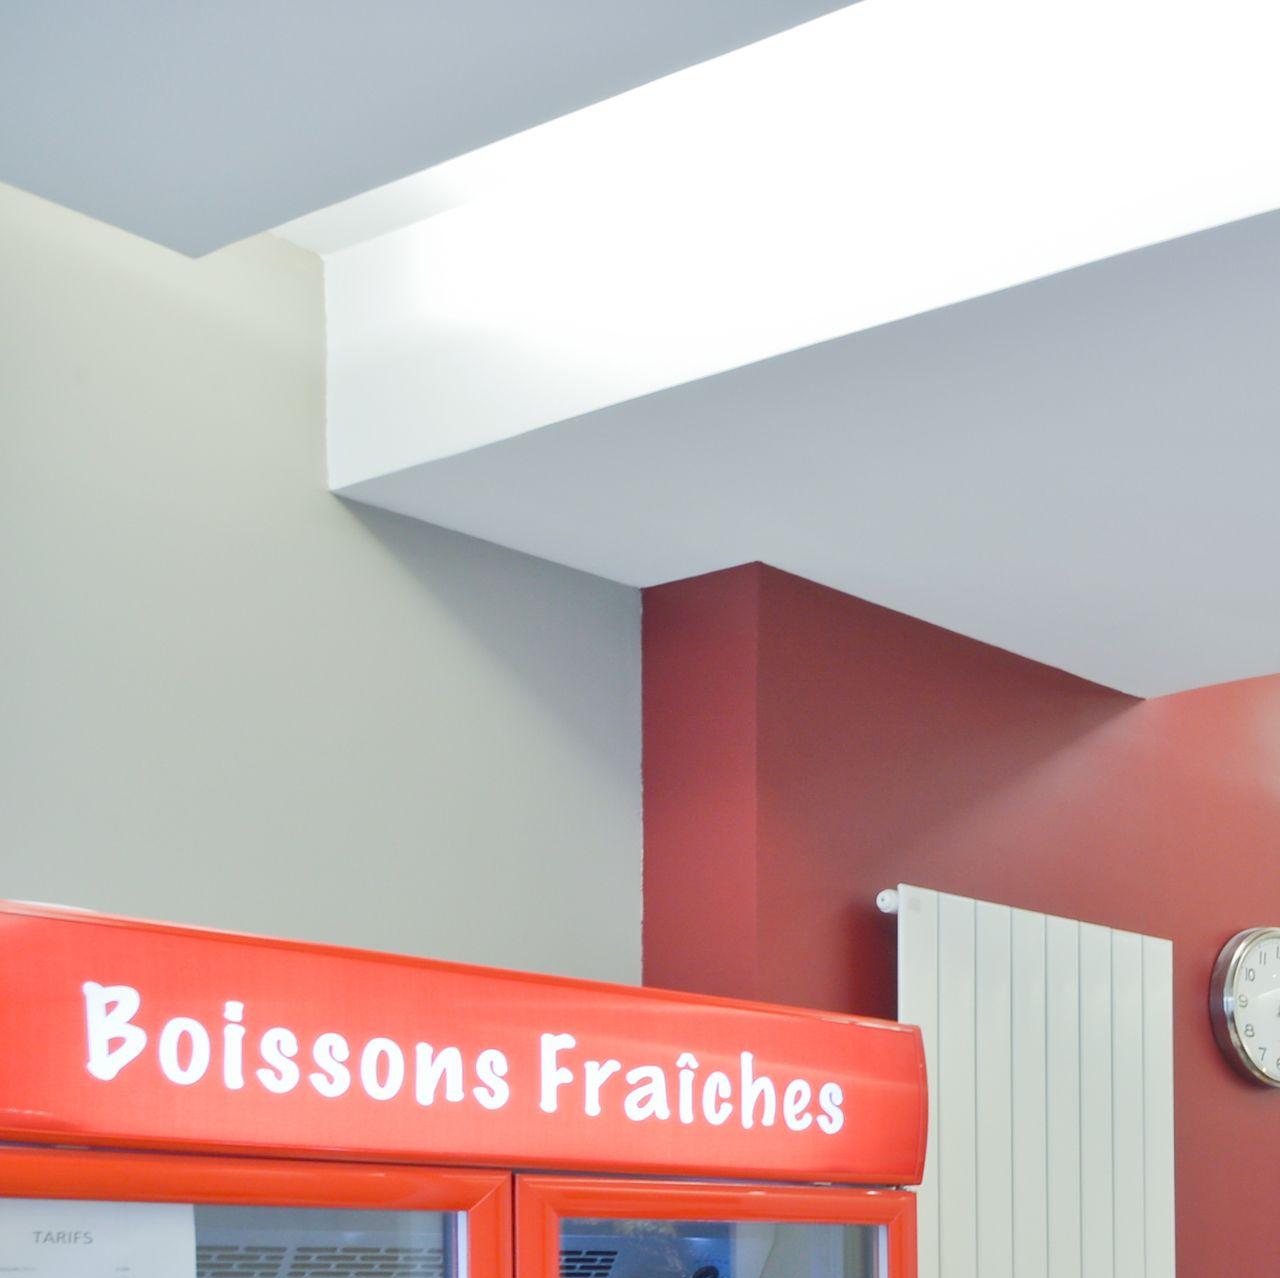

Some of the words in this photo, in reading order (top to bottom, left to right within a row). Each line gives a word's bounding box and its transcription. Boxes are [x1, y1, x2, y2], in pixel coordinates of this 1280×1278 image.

[1259, 951, 1267, 966] 11
[1245, 968, 1256, 982] 10
[1238, 994, 1249, 1008] 9
[1244, 1024, 1256, 1038] 8
[81, 980, 511, 1112] Boissons
[539, 1031, 847, 1135] Fraîches
[1258, 1047, 1267, 1061] 7
[32, 1230, 94, 1245] TARIFS
